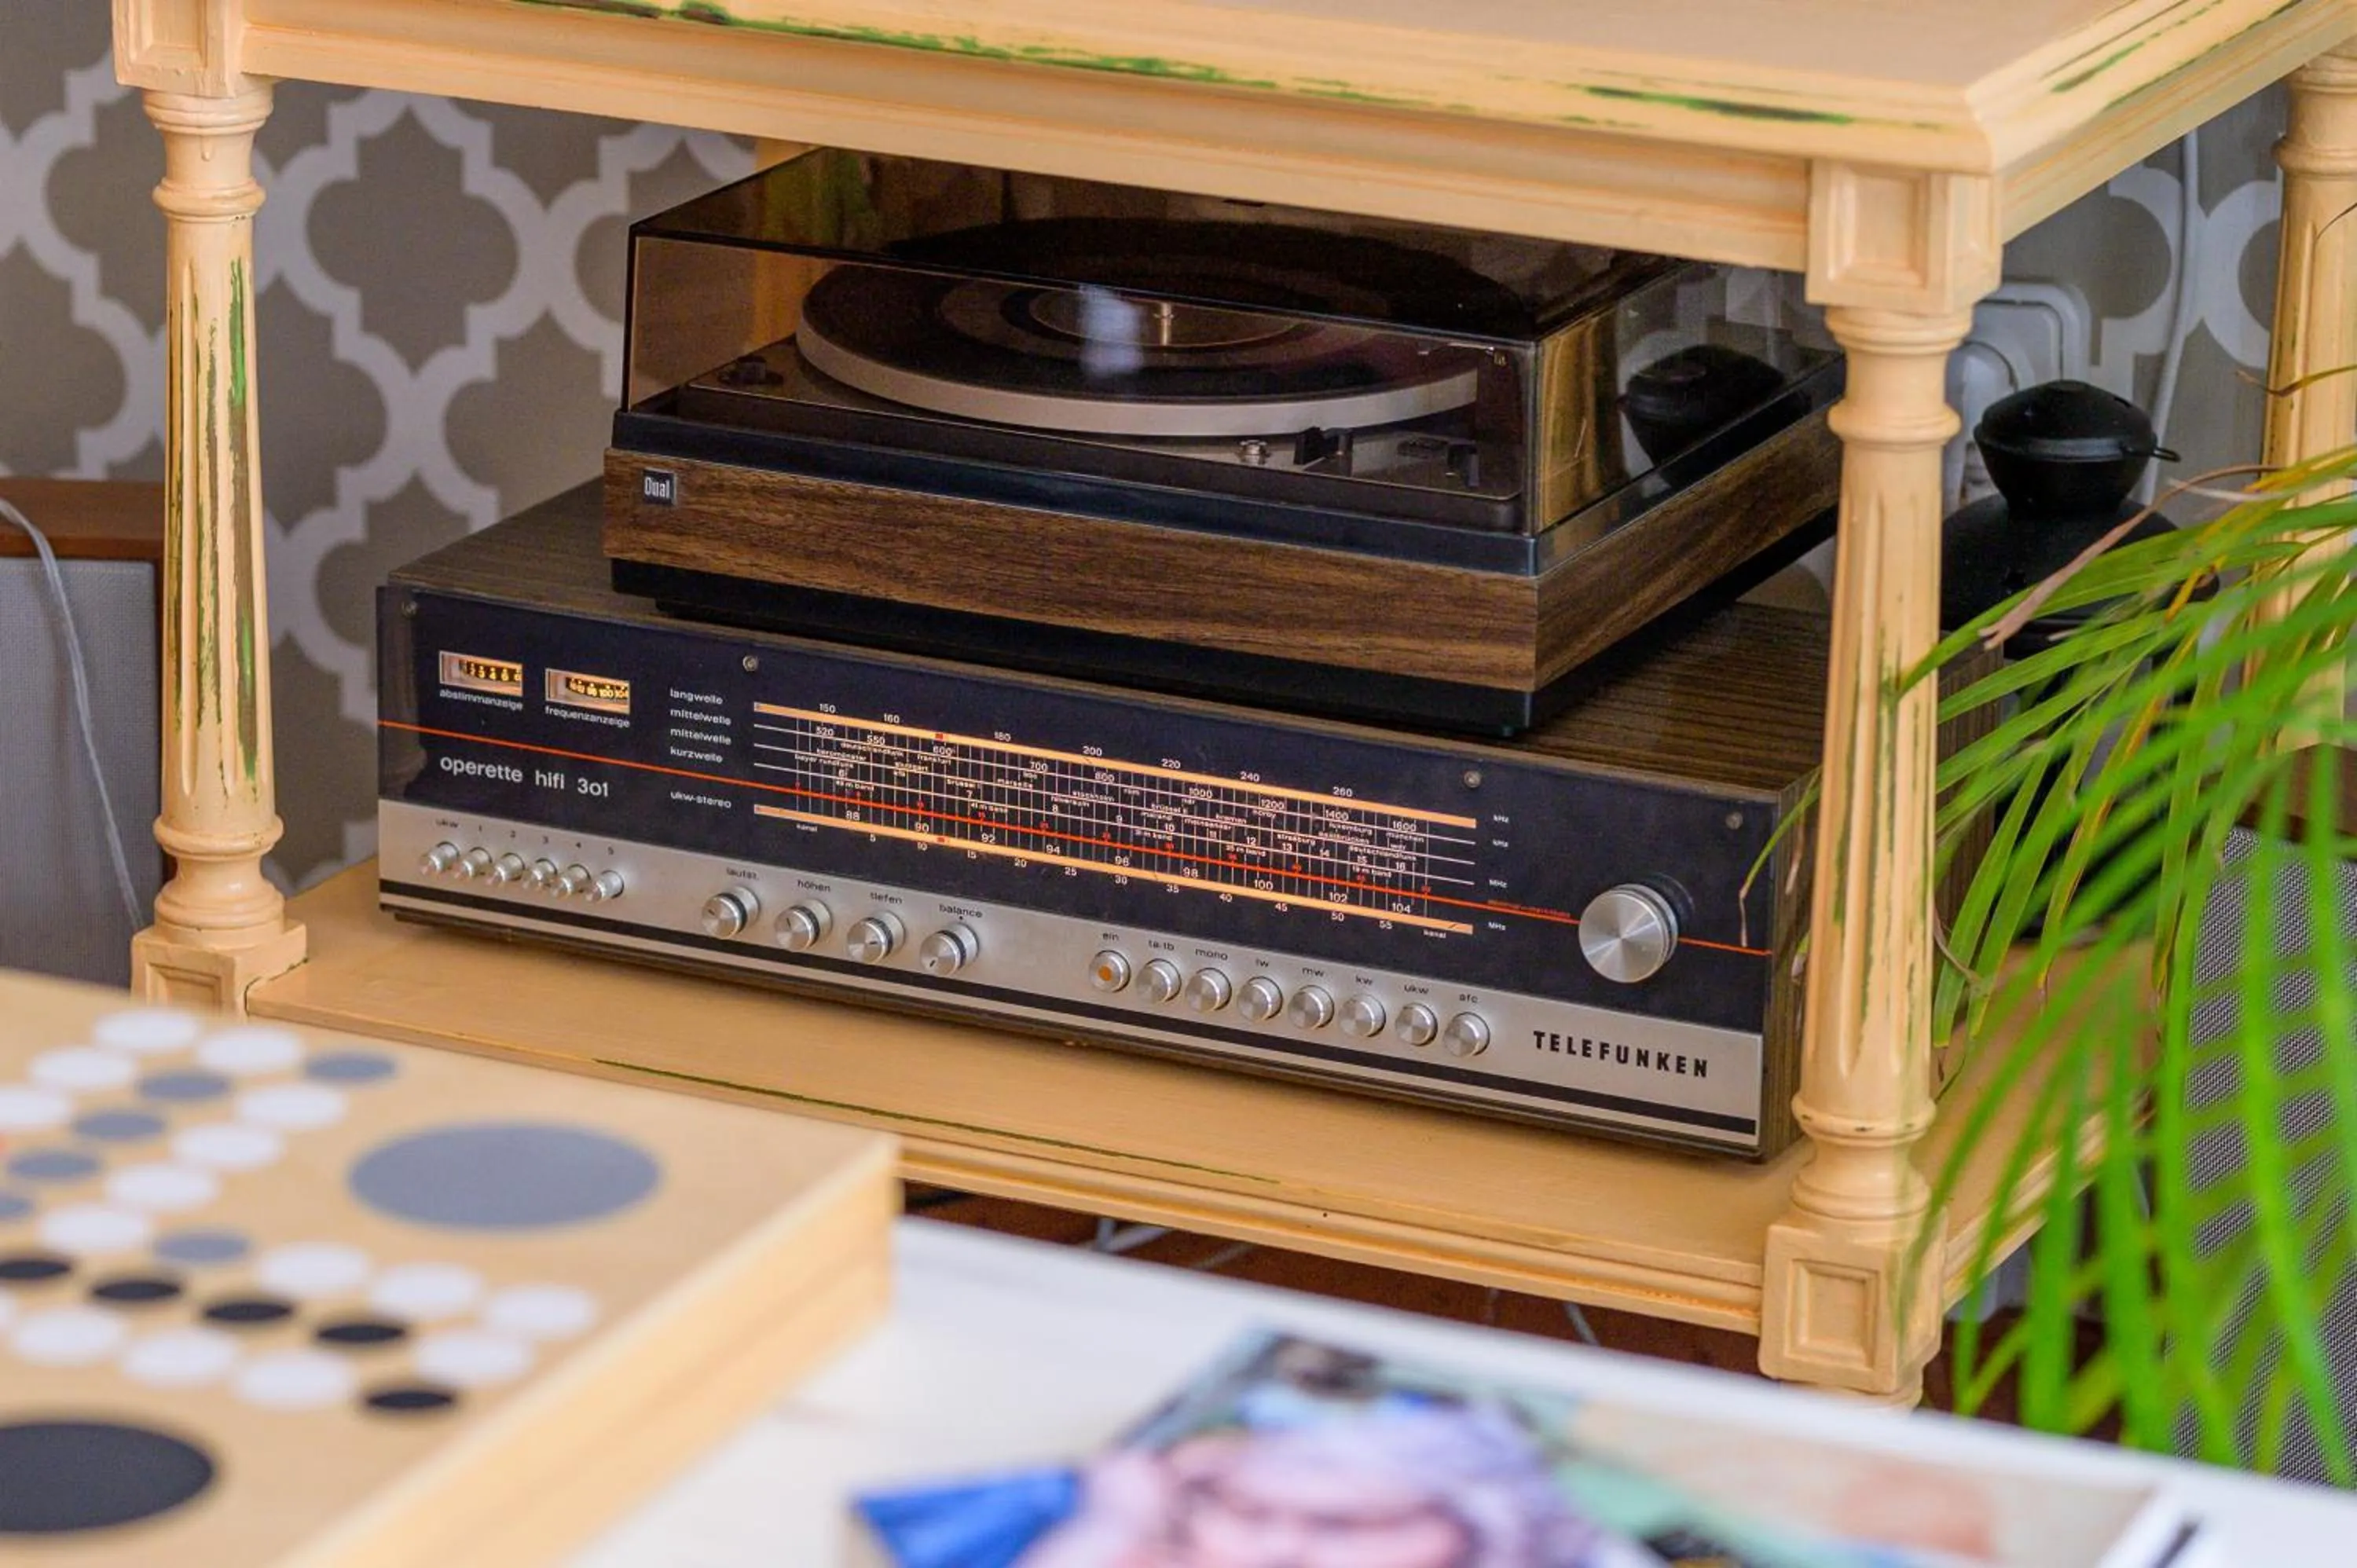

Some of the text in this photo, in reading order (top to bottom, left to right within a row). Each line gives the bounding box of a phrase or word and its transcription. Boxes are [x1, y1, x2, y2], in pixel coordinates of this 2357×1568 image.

[644, 476, 670, 499] Dual
[439, 688, 523, 711] abstimmanzeige
[669, 688, 723, 705] langwelle
[544, 705, 630, 728] frequenzanzeige
[670, 709, 731, 726] mittelwelle
[670, 727, 731, 746] mittelwelle
[670, 746, 723, 763] kurzwelle
[819, 703, 836, 713] 150
[883, 713, 900, 724] 160
[1083, 746, 1102, 757] 200
[1161, 758, 1181, 769] 220
[1240, 771, 1260, 782] 240
[1333, 786, 1353, 797] 260
[440, 757, 522, 783] operette
[535, 770, 565, 789] hifi
[867, 735, 885, 746] 550
[1030, 761, 1049, 772] 700
[1189, 788, 1213, 799] 1000
[1260, 799, 1285, 810] 1200
[1325, 809, 1349, 822] 1400
[1392, 820, 1417, 832] 1600
[670, 791, 731, 808] ukw-stereo
[1164, 823, 1175, 833] 10
[1246, 837, 1256, 846] 12
[1282, 842, 1292, 852] 13
[870, 833, 876, 843] 5
[918, 841, 927, 852] 10
[967, 850, 977, 859] 15
[1014, 858, 1027, 868] 20
[1065, 866, 1077, 877] 25
[1115, 875, 1127, 885] 30
[1166, 884, 1179, 894] 35
[1219, 893, 1232, 903] 40
[1274, 903, 1288, 913] 45
[1331, 911, 1344, 922] 50
[1379, 920, 1393, 930] 55
[981, 833, 995, 844] 92
[1046, 844, 1060, 855] 94
[1115, 855, 1130, 867] 96
[1183, 867, 1198, 878] 98
[1254, 879, 1274, 892] 100
[1329, 892, 1347, 903] 102
[1392, 903, 1411, 914] 104
[797, 878, 831, 893] höhen
[870, 891, 903, 905] tiefen
[939, 903, 983, 918] balance
[1102, 932, 1120, 942] ein
[1195, 947, 1229, 961] mono
[1302, 967, 1324, 978] mw
[1355, 975, 1373, 986] kw
[1404, 984, 1429, 996] ukw
[1459, 993, 1479, 1005] afc
[1533, 1030, 1707, 1078] TELEFUNKEN
